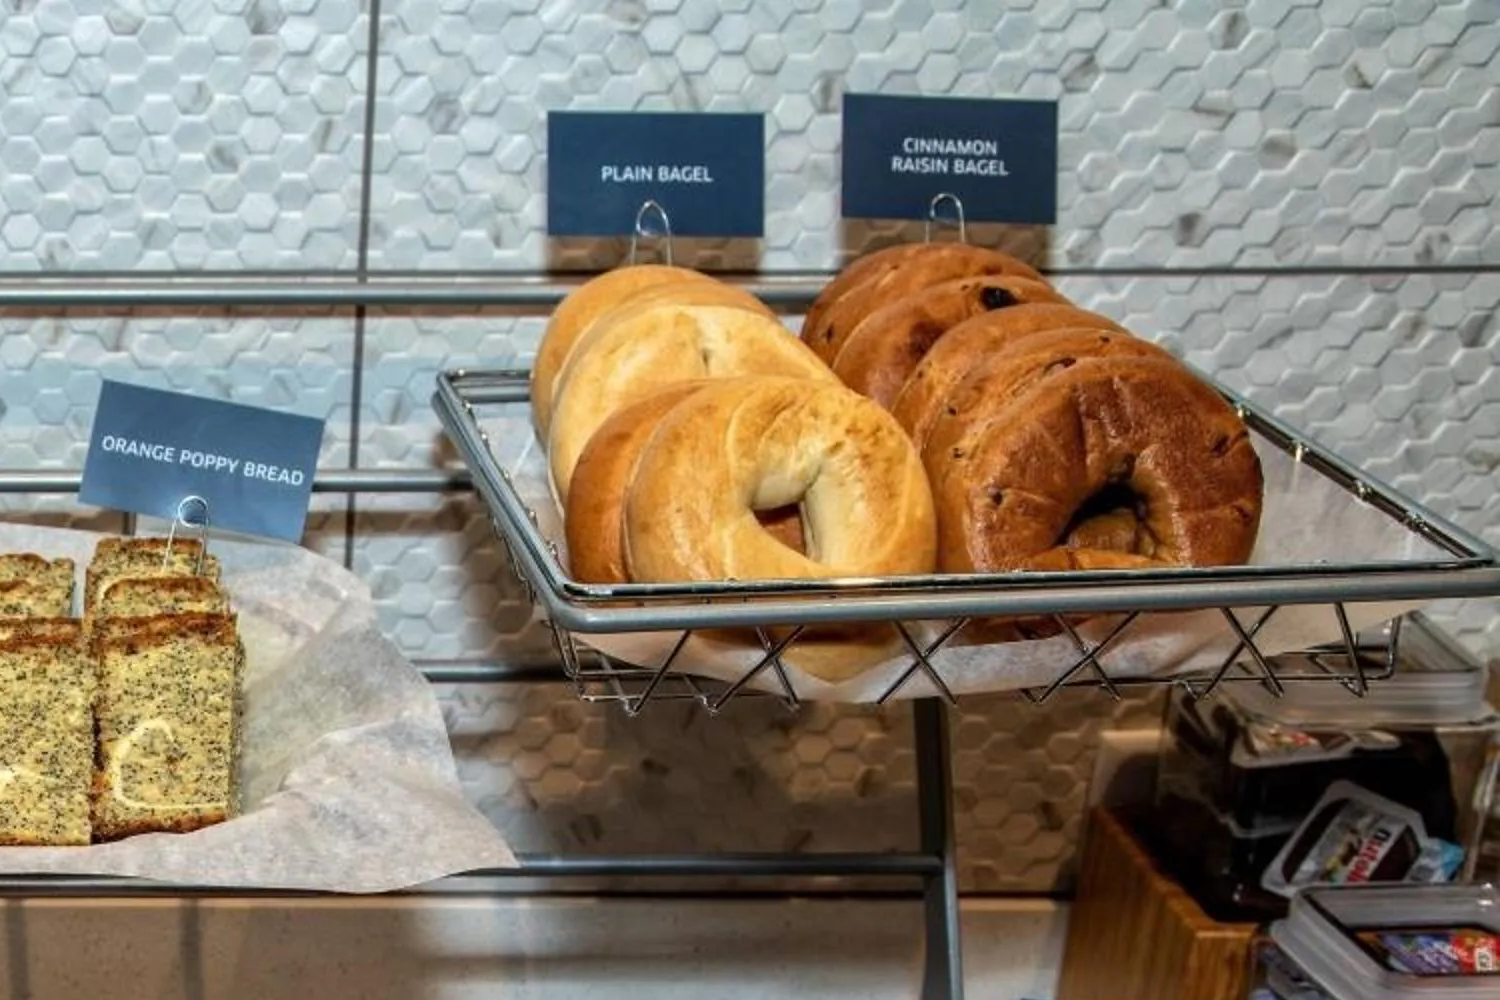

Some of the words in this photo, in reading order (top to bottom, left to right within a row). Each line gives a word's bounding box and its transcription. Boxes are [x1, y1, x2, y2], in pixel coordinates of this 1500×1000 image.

[903, 138, 997, 156] CINNAMON
[602, 166, 652, 182] PLAIN
[658, 166, 713, 182] BAGEL
[892, 156, 948, 173] RAISIN
[954, 158, 1008, 176] BAGEL
[102, 436, 175, 462] ORANGE
[180, 450, 239, 473] POPPY
[244, 462, 304, 486] BREAD
